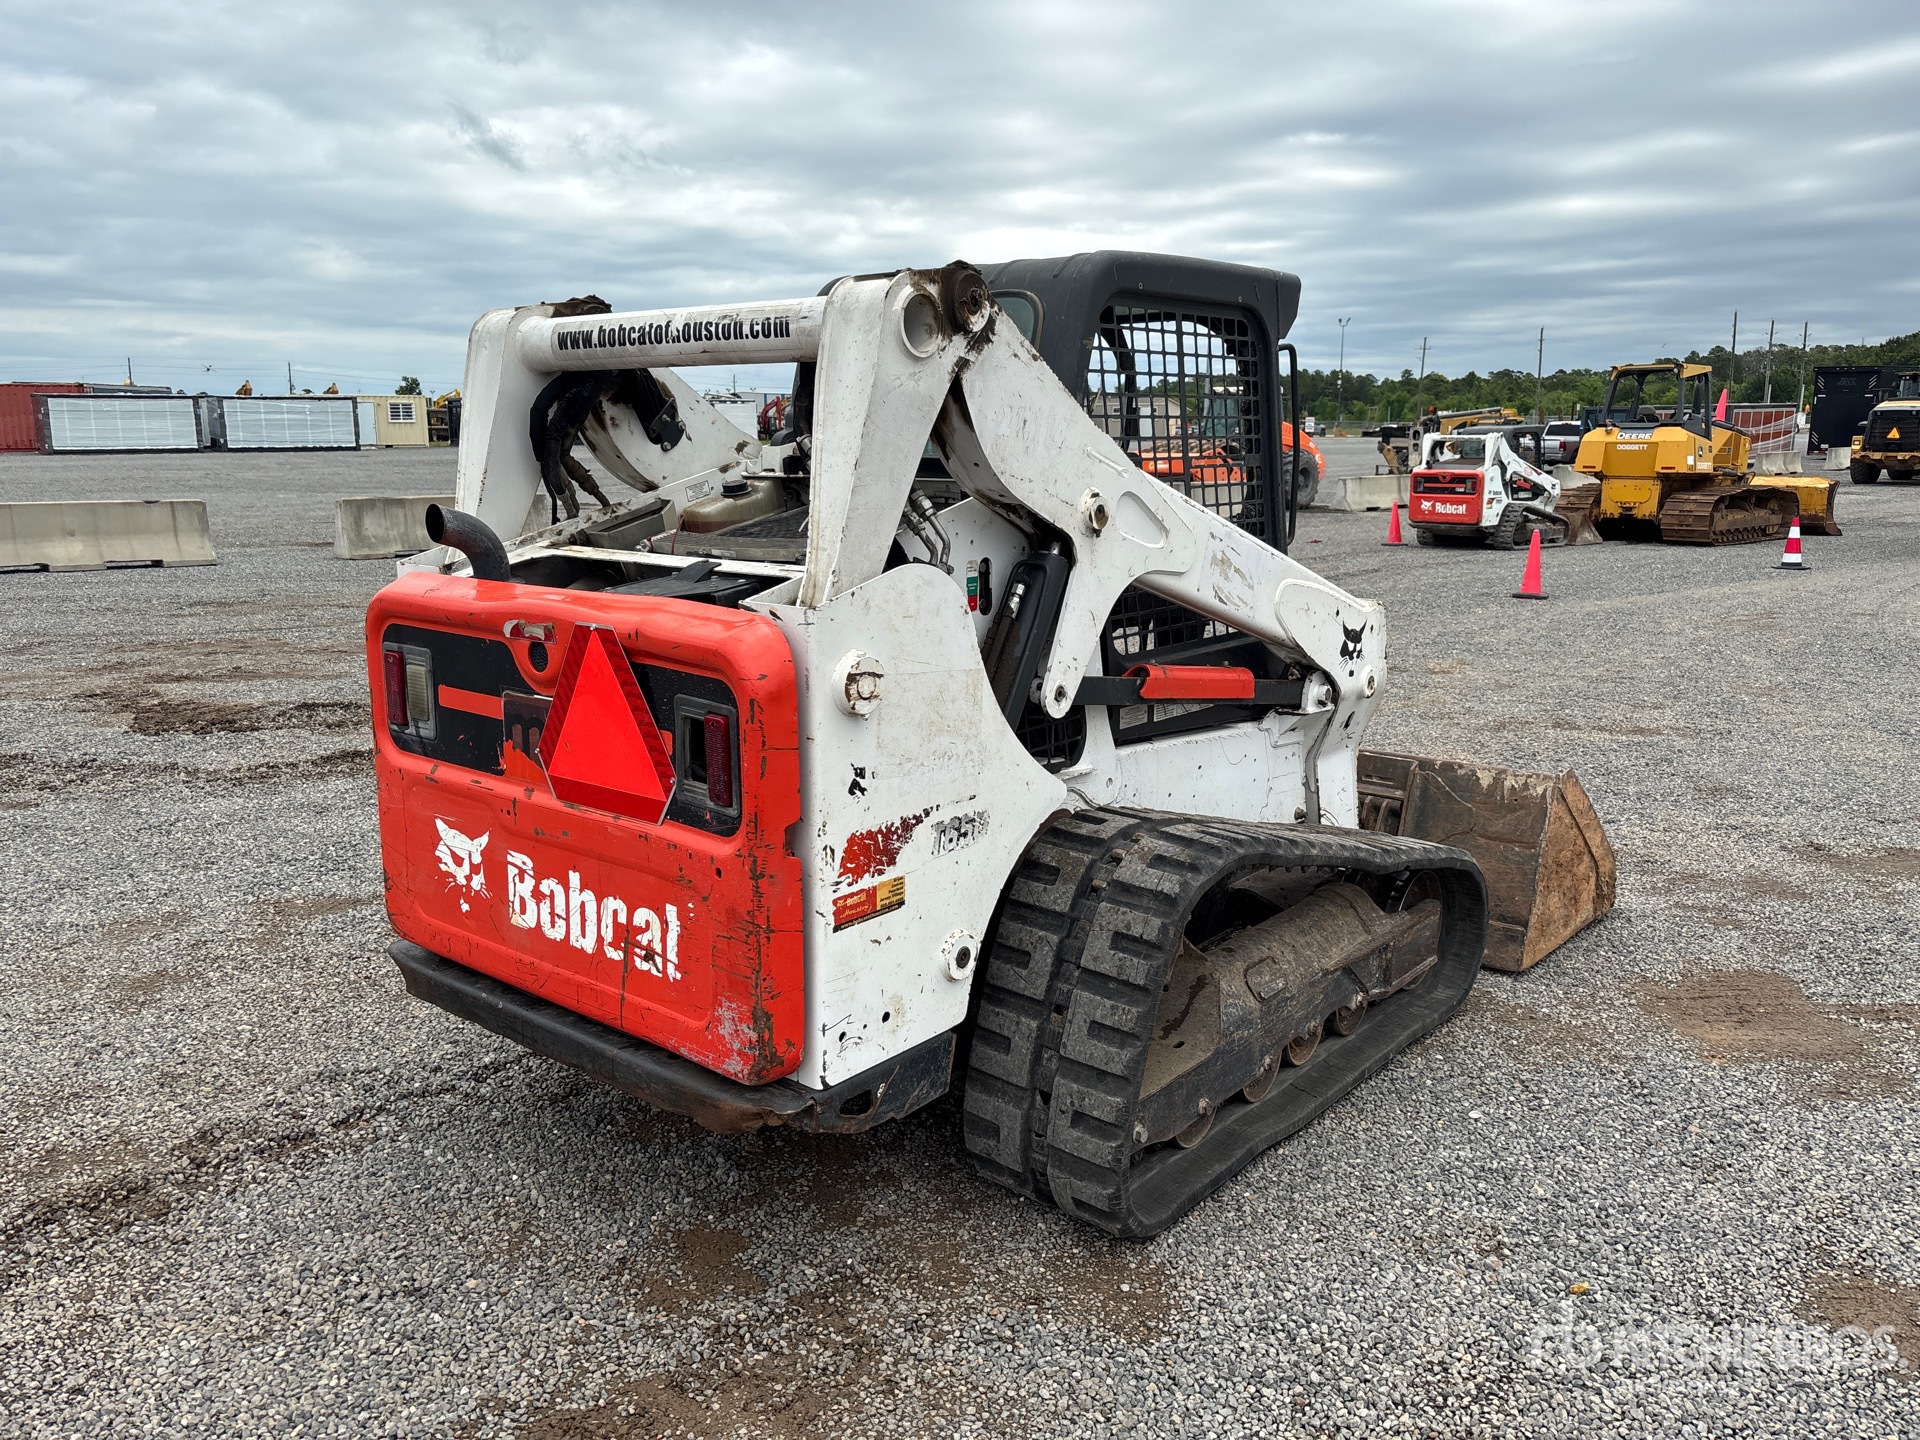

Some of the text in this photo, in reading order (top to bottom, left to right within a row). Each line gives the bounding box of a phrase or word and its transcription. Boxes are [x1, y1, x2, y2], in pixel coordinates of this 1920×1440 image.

[1617, 432, 1652, 440] DEERE
[1435, 502, 1467, 514] Bobcat
[507, 849, 681, 981] Bobcat
